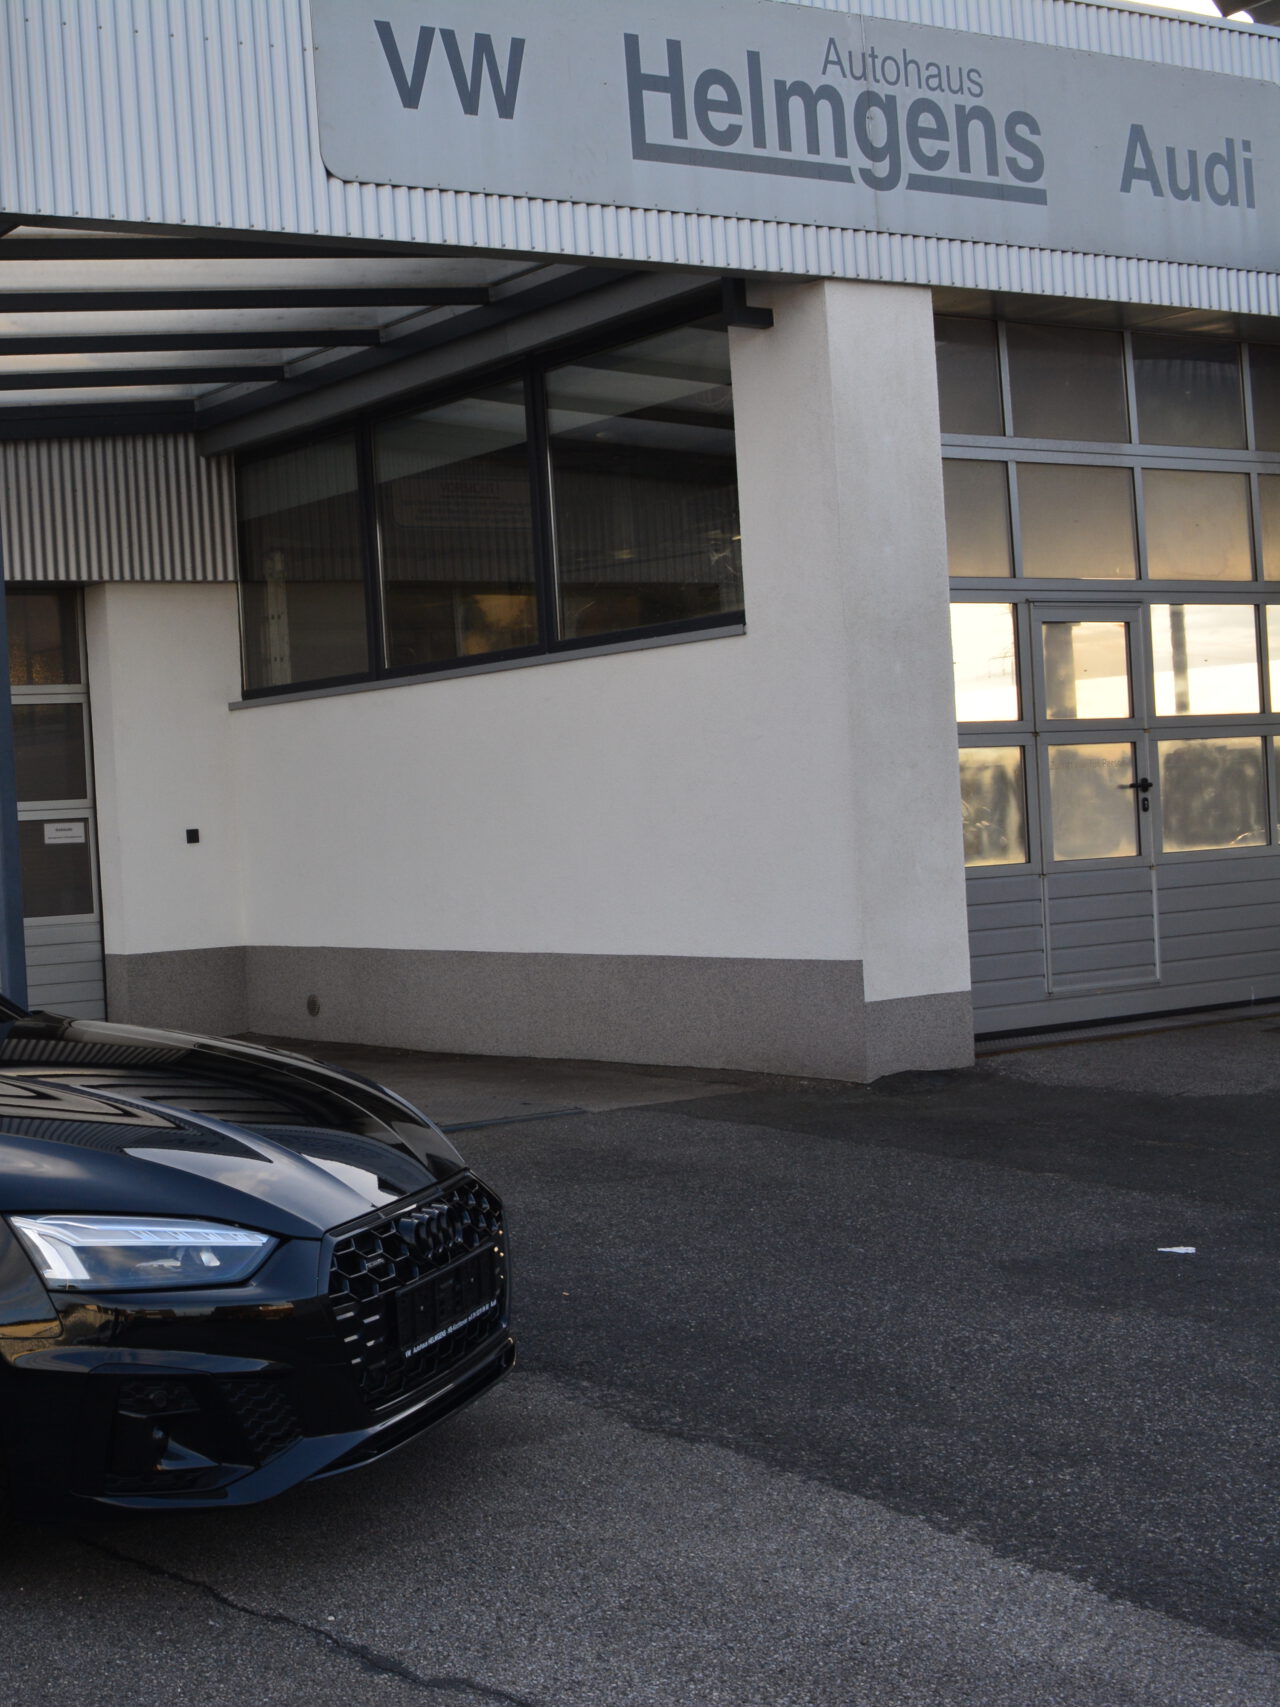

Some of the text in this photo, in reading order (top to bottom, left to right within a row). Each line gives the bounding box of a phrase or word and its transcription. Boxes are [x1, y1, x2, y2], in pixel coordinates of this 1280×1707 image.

[373, 19, 526, 120] VW
[623, 32, 1046, 192] Helmgens
[821, 37, 984, 98] Autohaus
[1119, 123, 1256, 209] Audi
